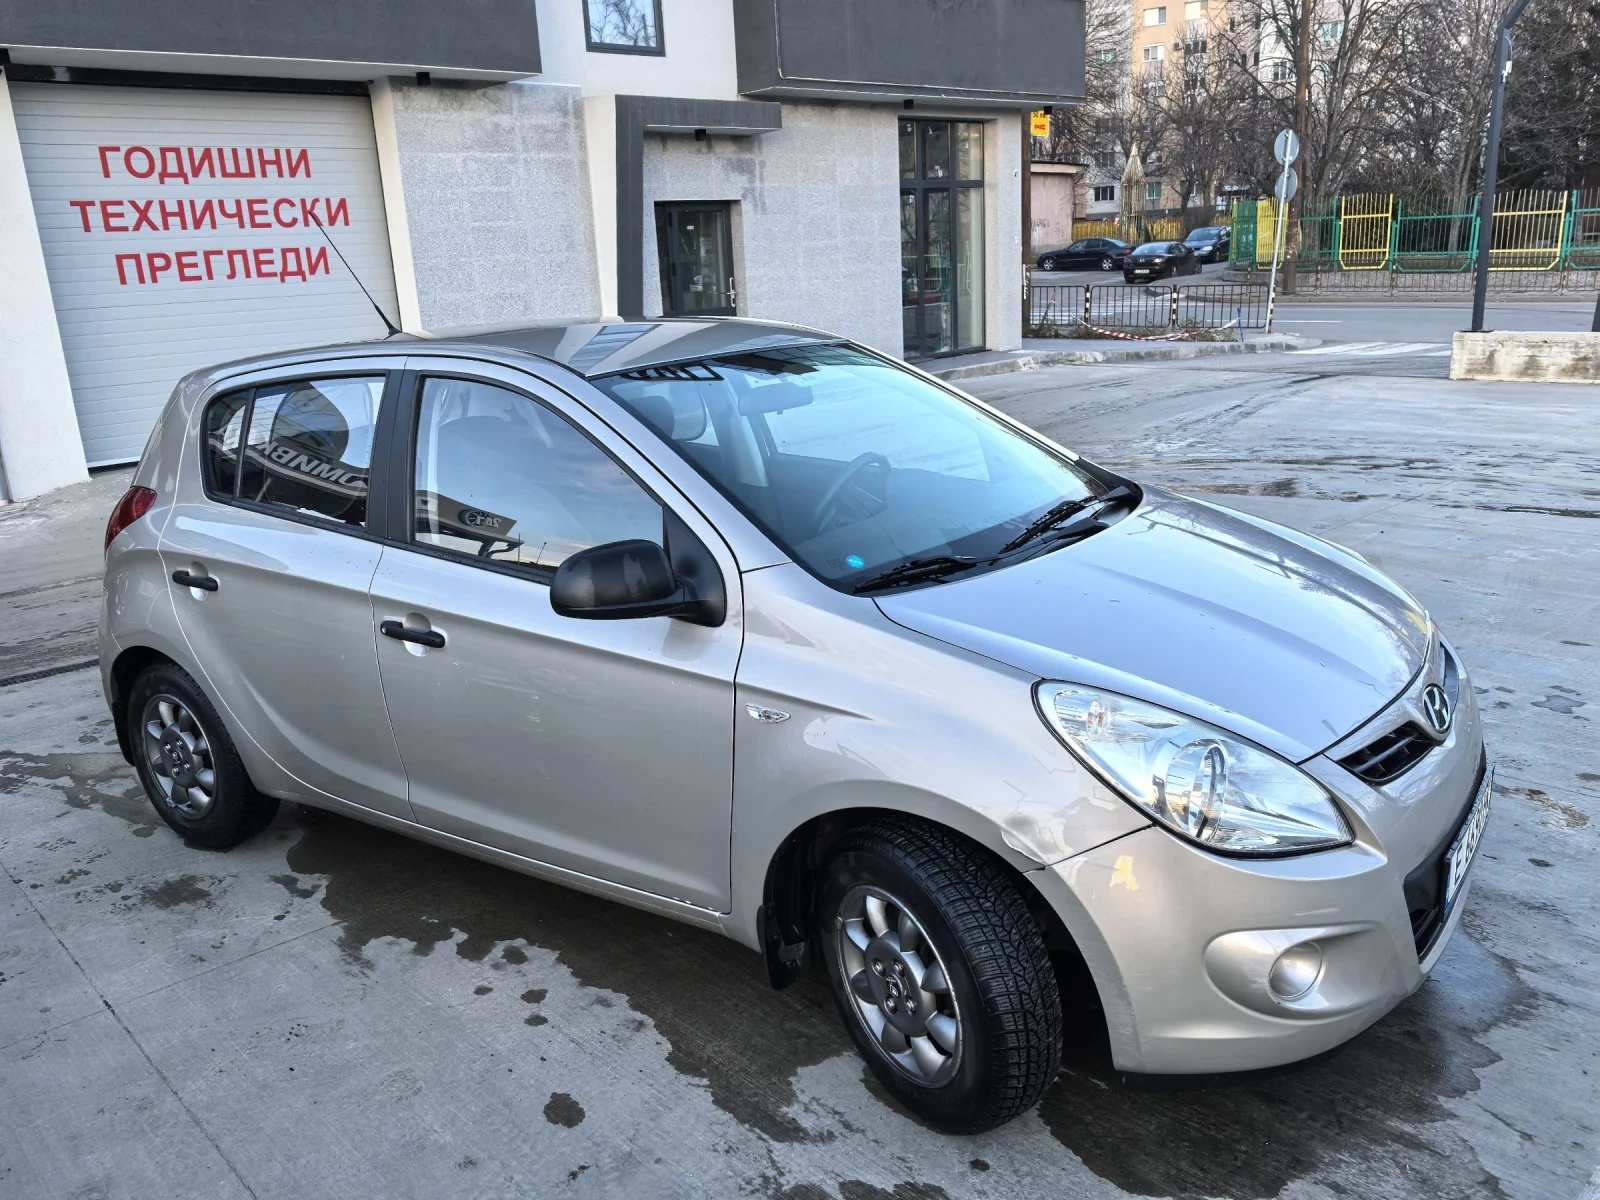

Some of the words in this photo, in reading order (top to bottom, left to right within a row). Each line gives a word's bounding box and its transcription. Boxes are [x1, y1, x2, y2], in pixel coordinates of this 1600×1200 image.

[98, 146, 311, 185] ГОДИШНИ
[70, 198, 350, 233] ТЕХНИЧЕСКИ
[115, 247, 330, 285] ПРЕГЛЕДИ
